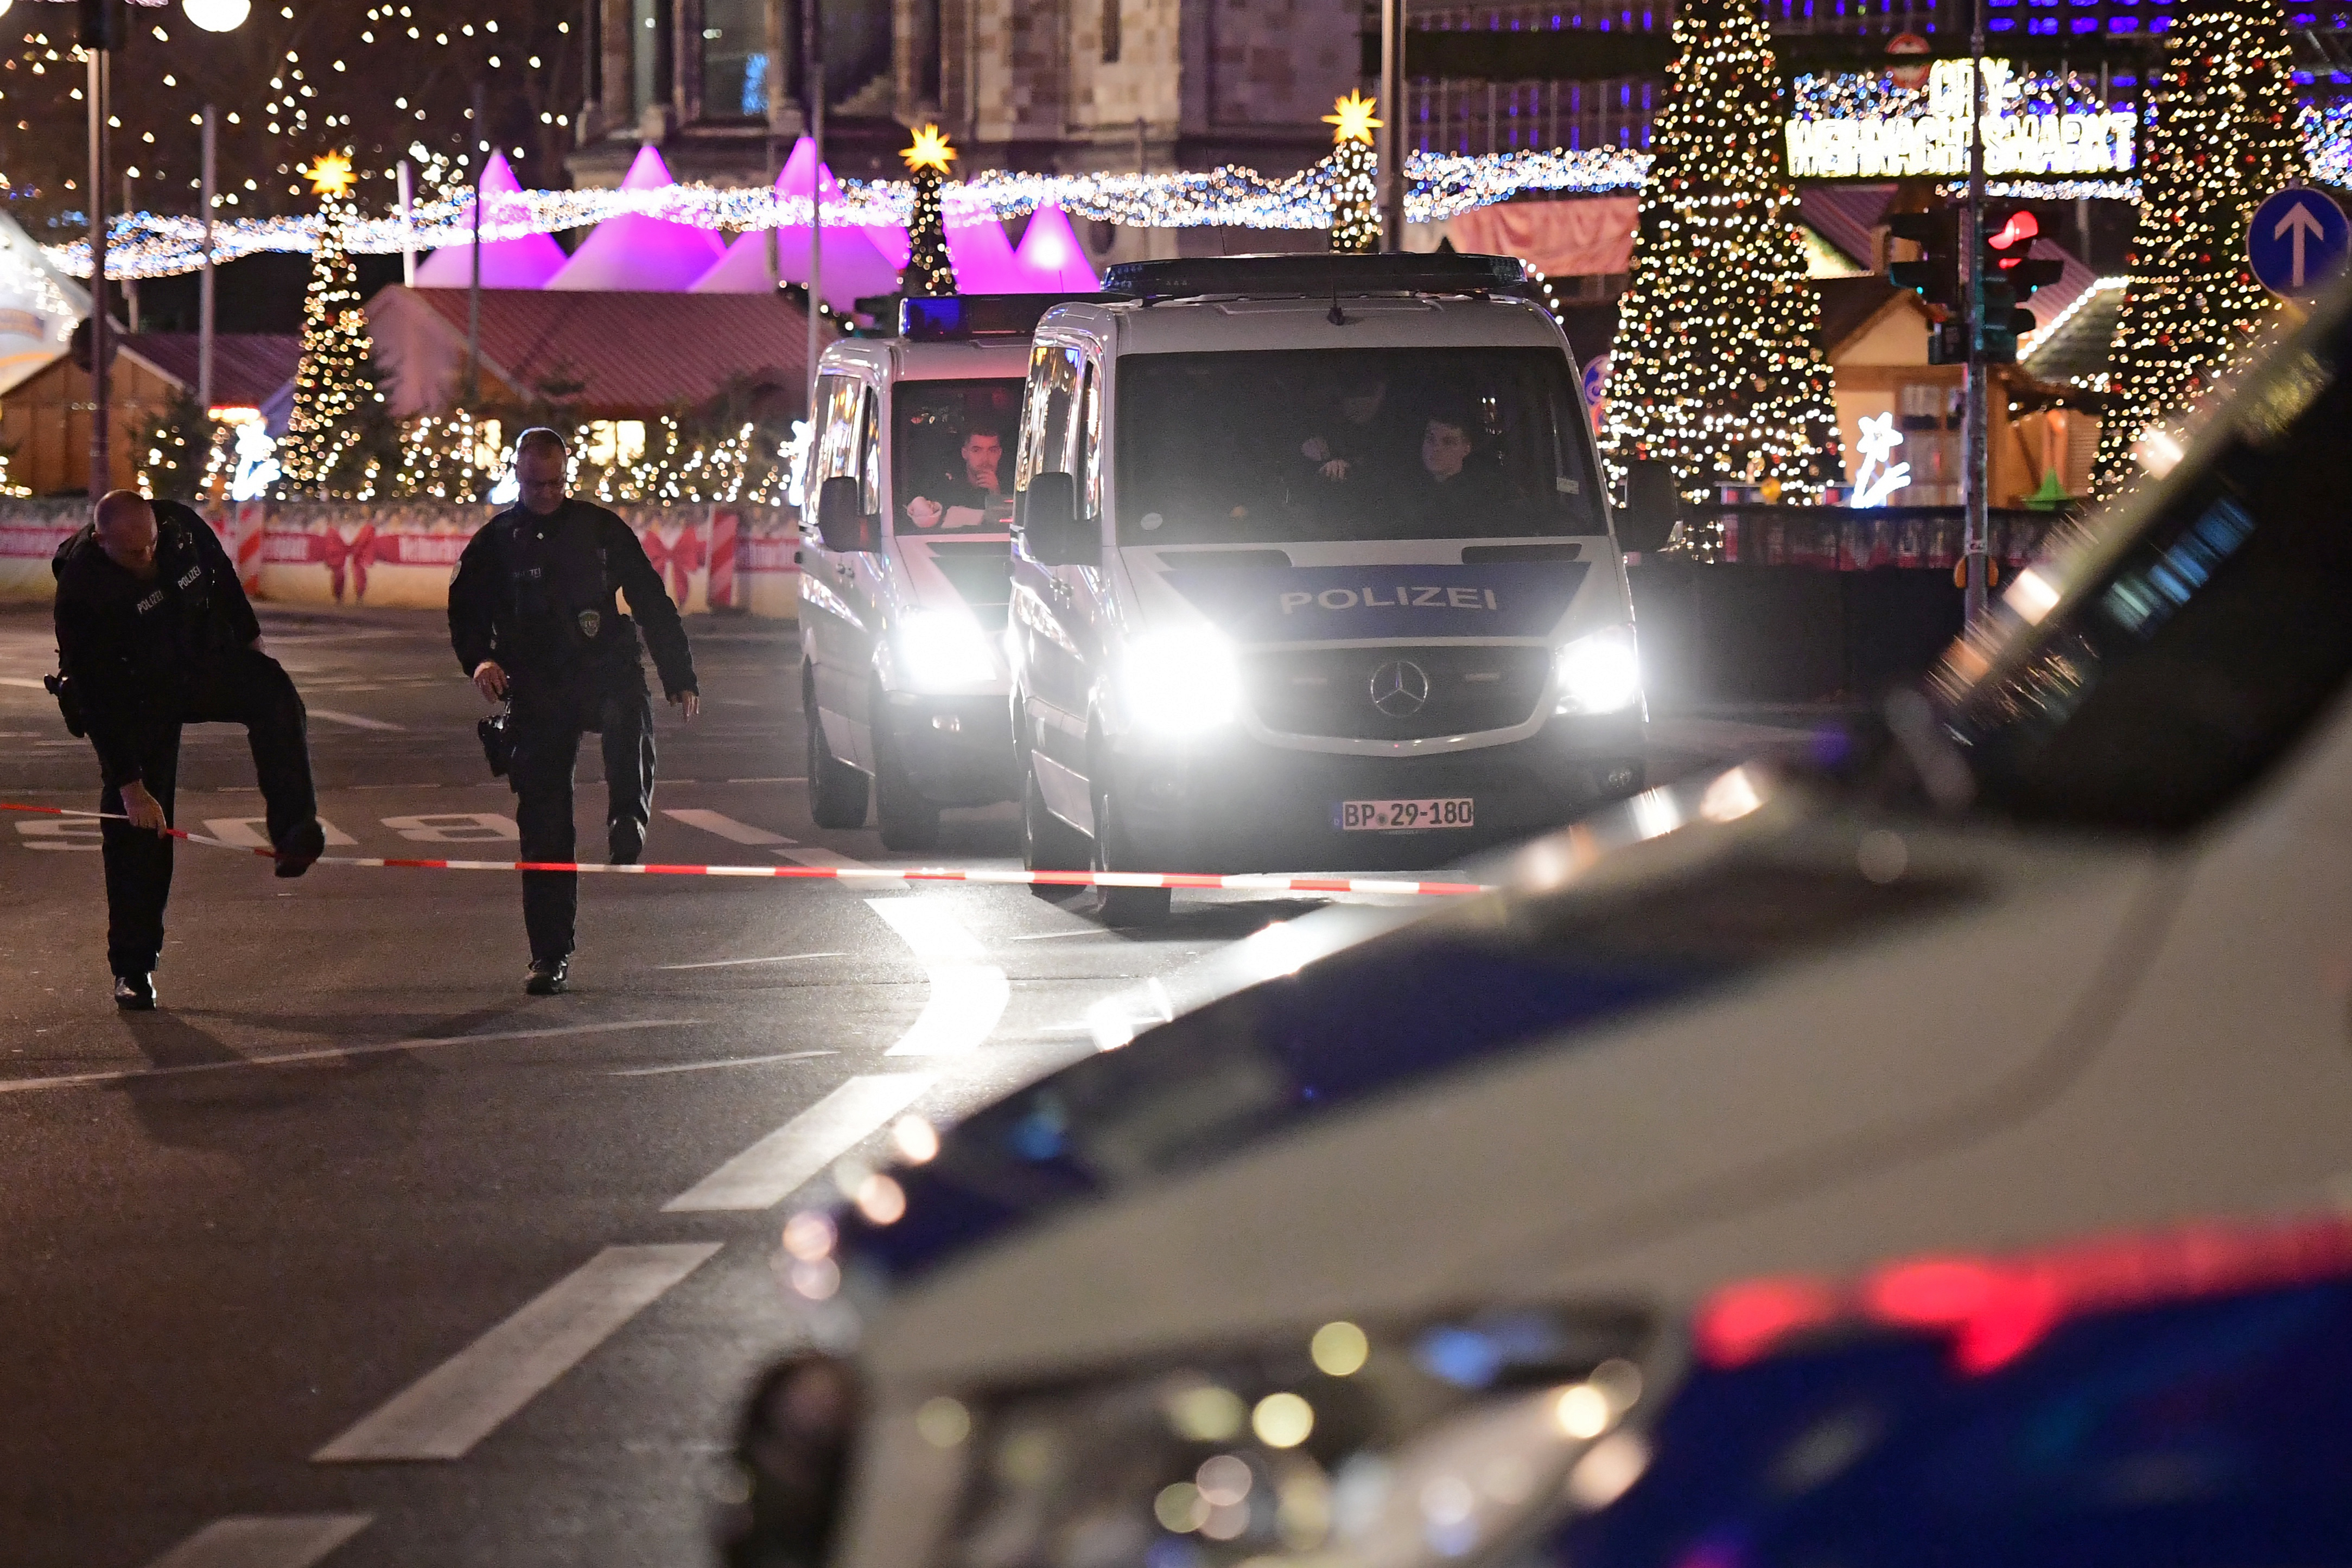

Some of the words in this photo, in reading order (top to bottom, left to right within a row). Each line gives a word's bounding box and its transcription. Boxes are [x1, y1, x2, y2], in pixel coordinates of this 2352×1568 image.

[177, 565, 202, 590] POLIZEI
[137, 590, 164, 615] POLIZEI
[1280, 587, 1497, 615] POLIZEI
